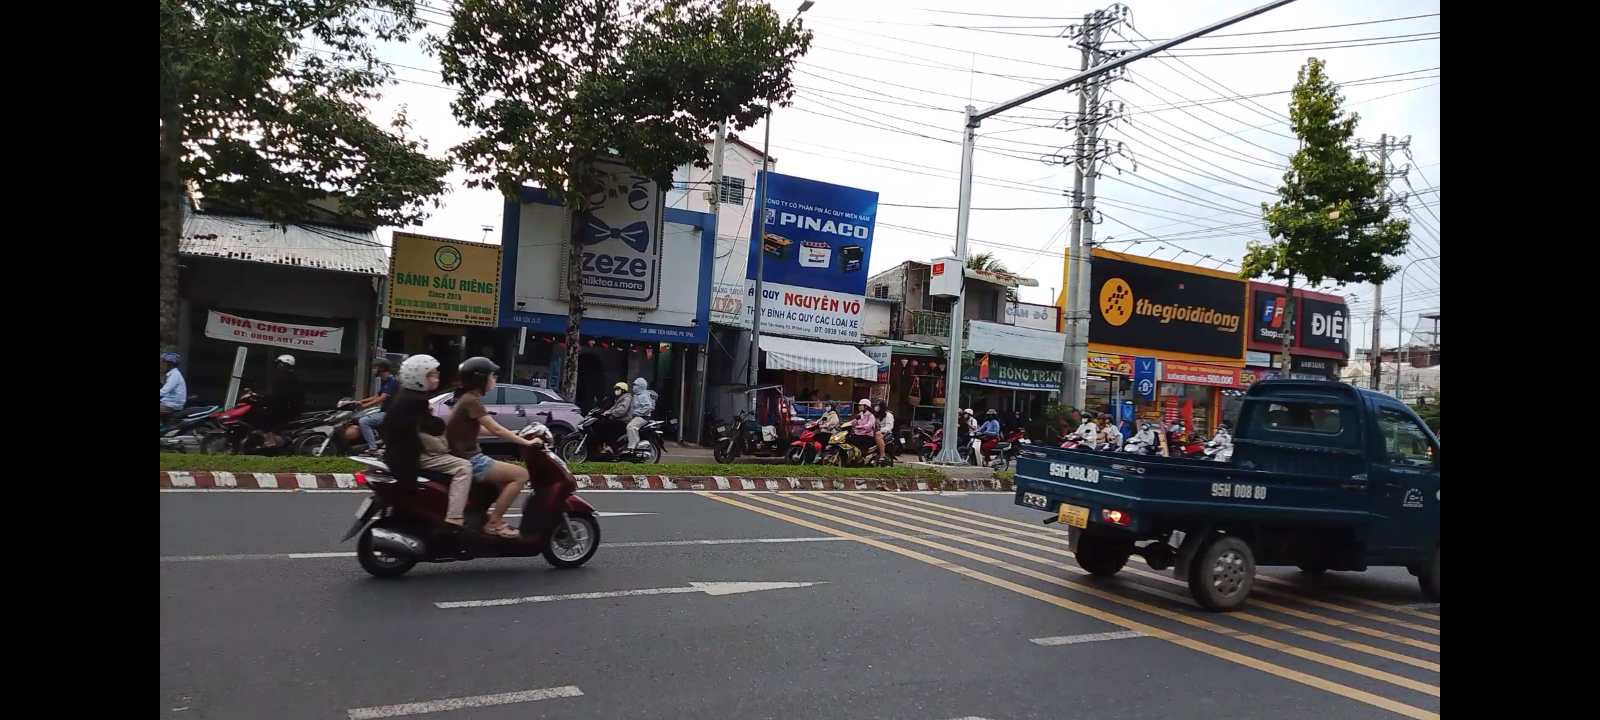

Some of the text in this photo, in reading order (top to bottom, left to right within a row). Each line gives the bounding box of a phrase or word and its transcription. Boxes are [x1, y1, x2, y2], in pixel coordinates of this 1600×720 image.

[780, 211, 869, 239] PINACO
[582, 252, 647, 278] zeze
[396, 271, 430, 287] BÁNH
[459, 278, 493, 294] RIÊNG
[620, 281, 643, 290] more
[428, 290, 462, 301] Since 2015
[762, 289, 780, 300] QUY
[843, 300, 860, 315] VÕ
[746, 306, 766, 316] THY
[767, 306, 785, 319] BÌNH
[798, 312, 814, 322] QUY
[814, 314, 830, 324] CÁC
[832, 317, 848, 328] LOẠI
[848, 320, 858, 328] XE
[1135, 298, 1240, 332] thegioididong
[256, 322, 288, 334] CHO
[999, 362, 1029, 381] HỒNG
[1301, 361, 1325, 369] SAMSUNG
[1049, 462, 1100, 484] 95H-008.80
[1211, 482, 1266, 500] 95H 008 80
